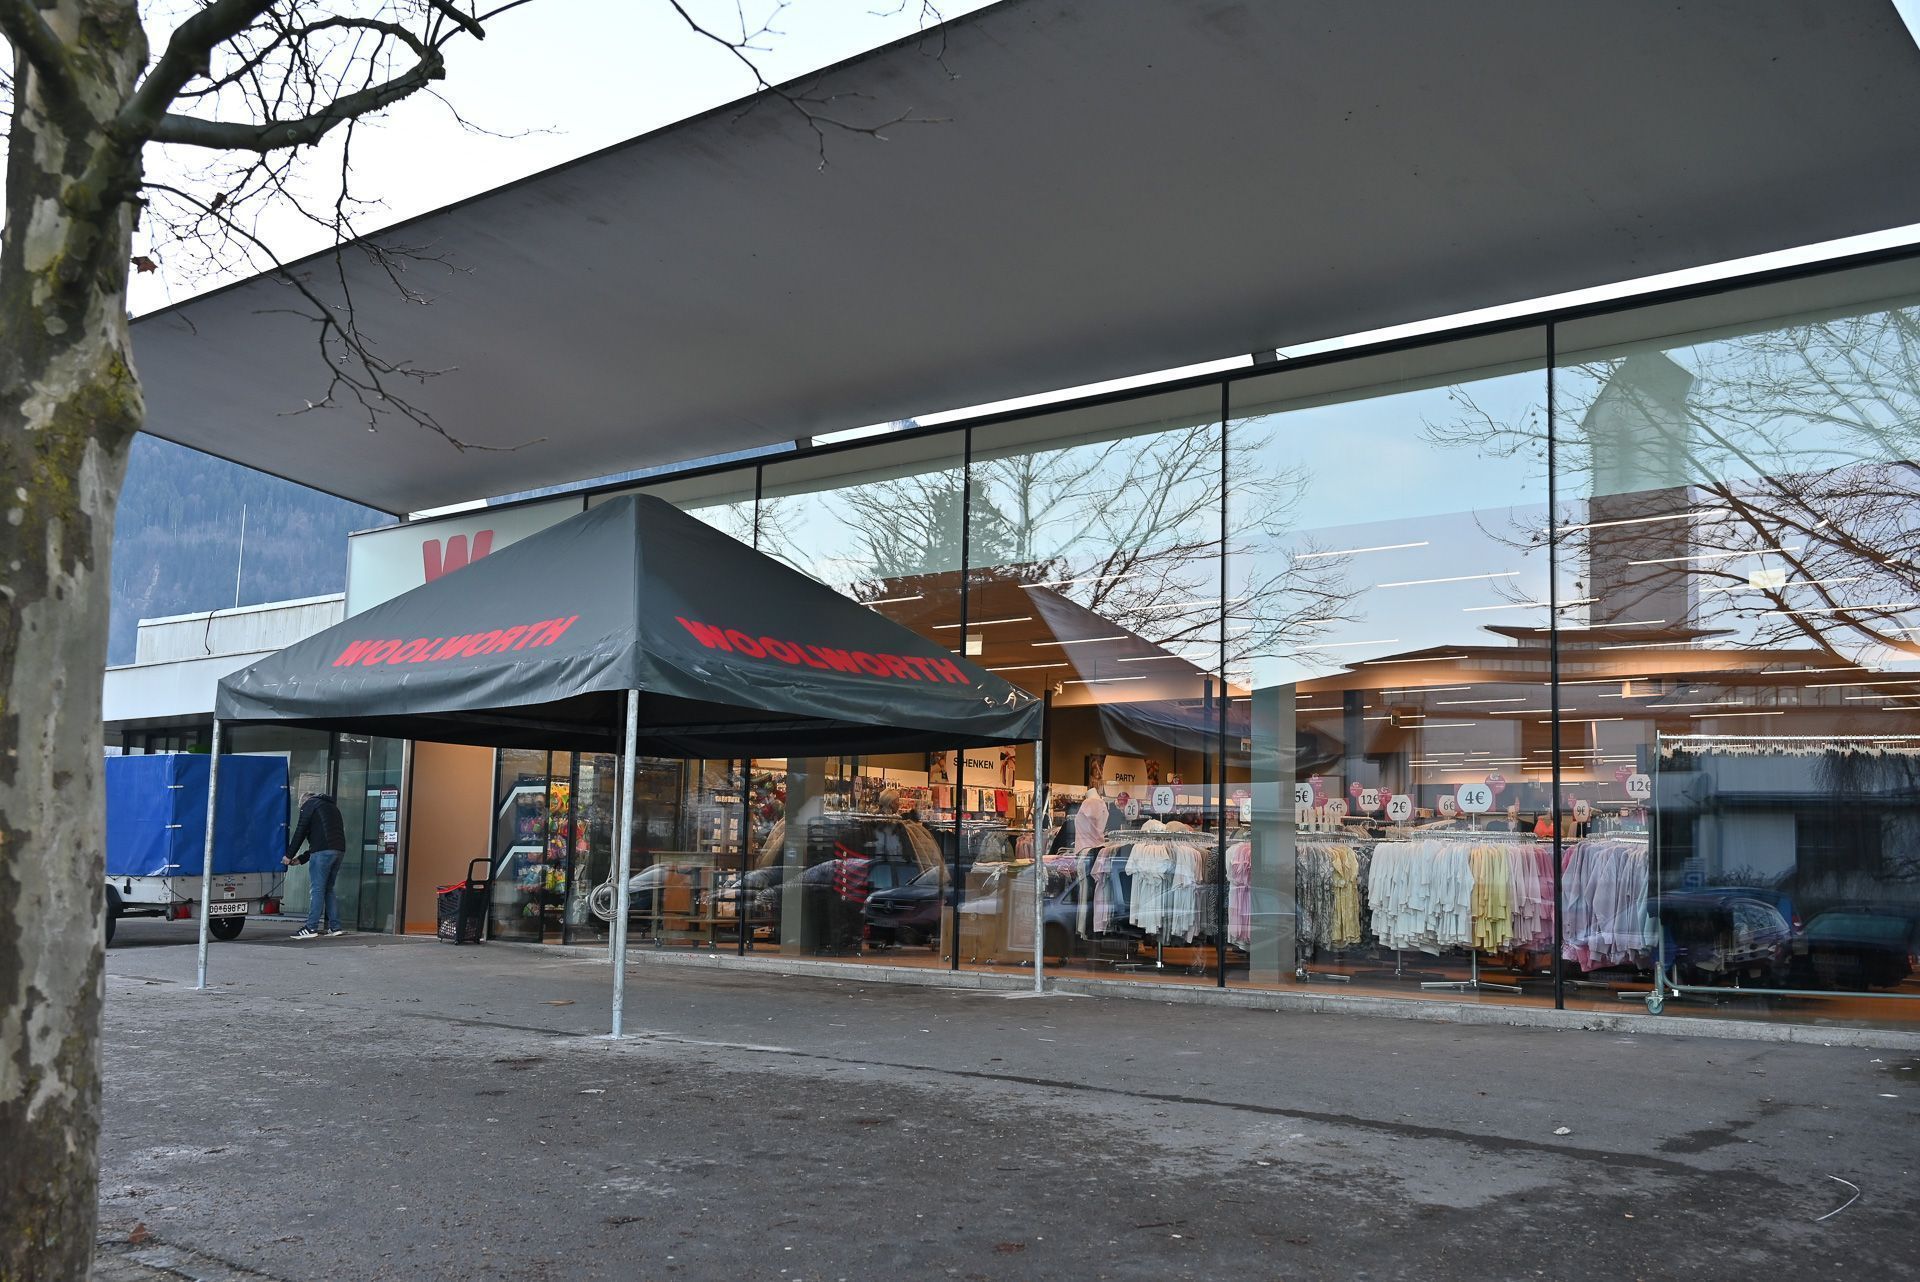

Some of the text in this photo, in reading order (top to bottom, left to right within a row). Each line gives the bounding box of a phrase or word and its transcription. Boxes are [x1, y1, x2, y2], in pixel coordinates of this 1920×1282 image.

[423, 530, 495, 584] W
[332, 615, 579, 667] WOOLWORTH
[676, 616, 970, 684] WOOLWORTH
[953, 757, 994, 769] SHENKEN
[1115, 773, 1136, 783] PARTY
[1628, 780, 1651, 792] 12€
[1157, 793, 1170, 806] 5€
[1361, 794, 1379, 805] 12€
[1464, 791, 1485, 805] 4€
[1392, 801, 1407, 813] 2€
[1576, 805, 1586, 816] 9€
